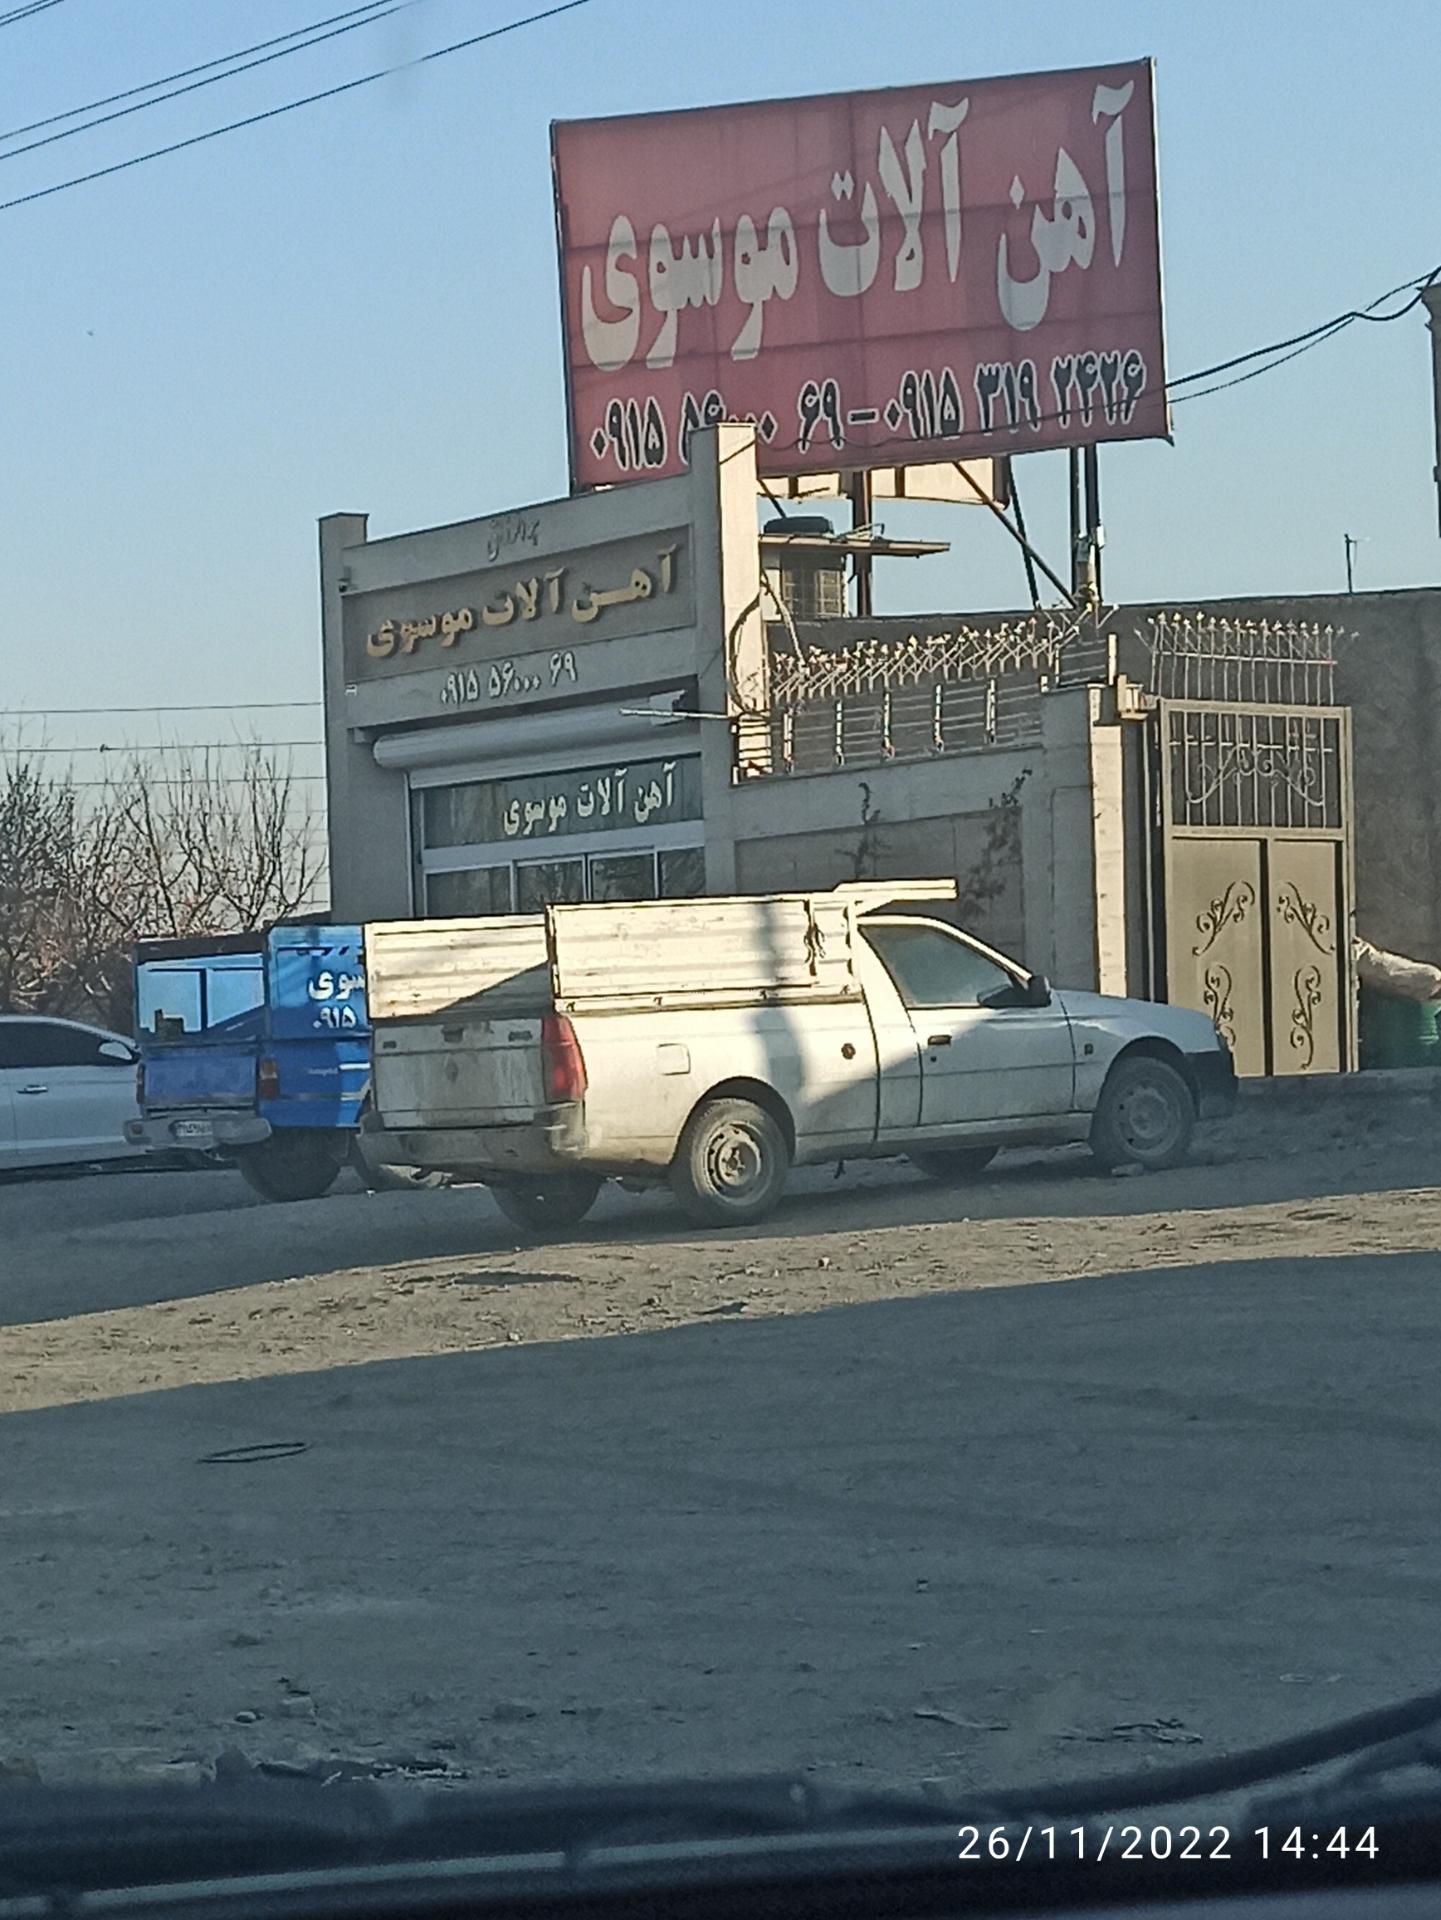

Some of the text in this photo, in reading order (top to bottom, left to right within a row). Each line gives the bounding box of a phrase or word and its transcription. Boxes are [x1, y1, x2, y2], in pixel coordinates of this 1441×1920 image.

[581, 80, 1135, 372] آهن آلات موسوی
[571, 543, 678, 622] آهن
[366, 606, 474, 658] موسوی
[503, 761, 676, 836] آهن آلات موسوی
